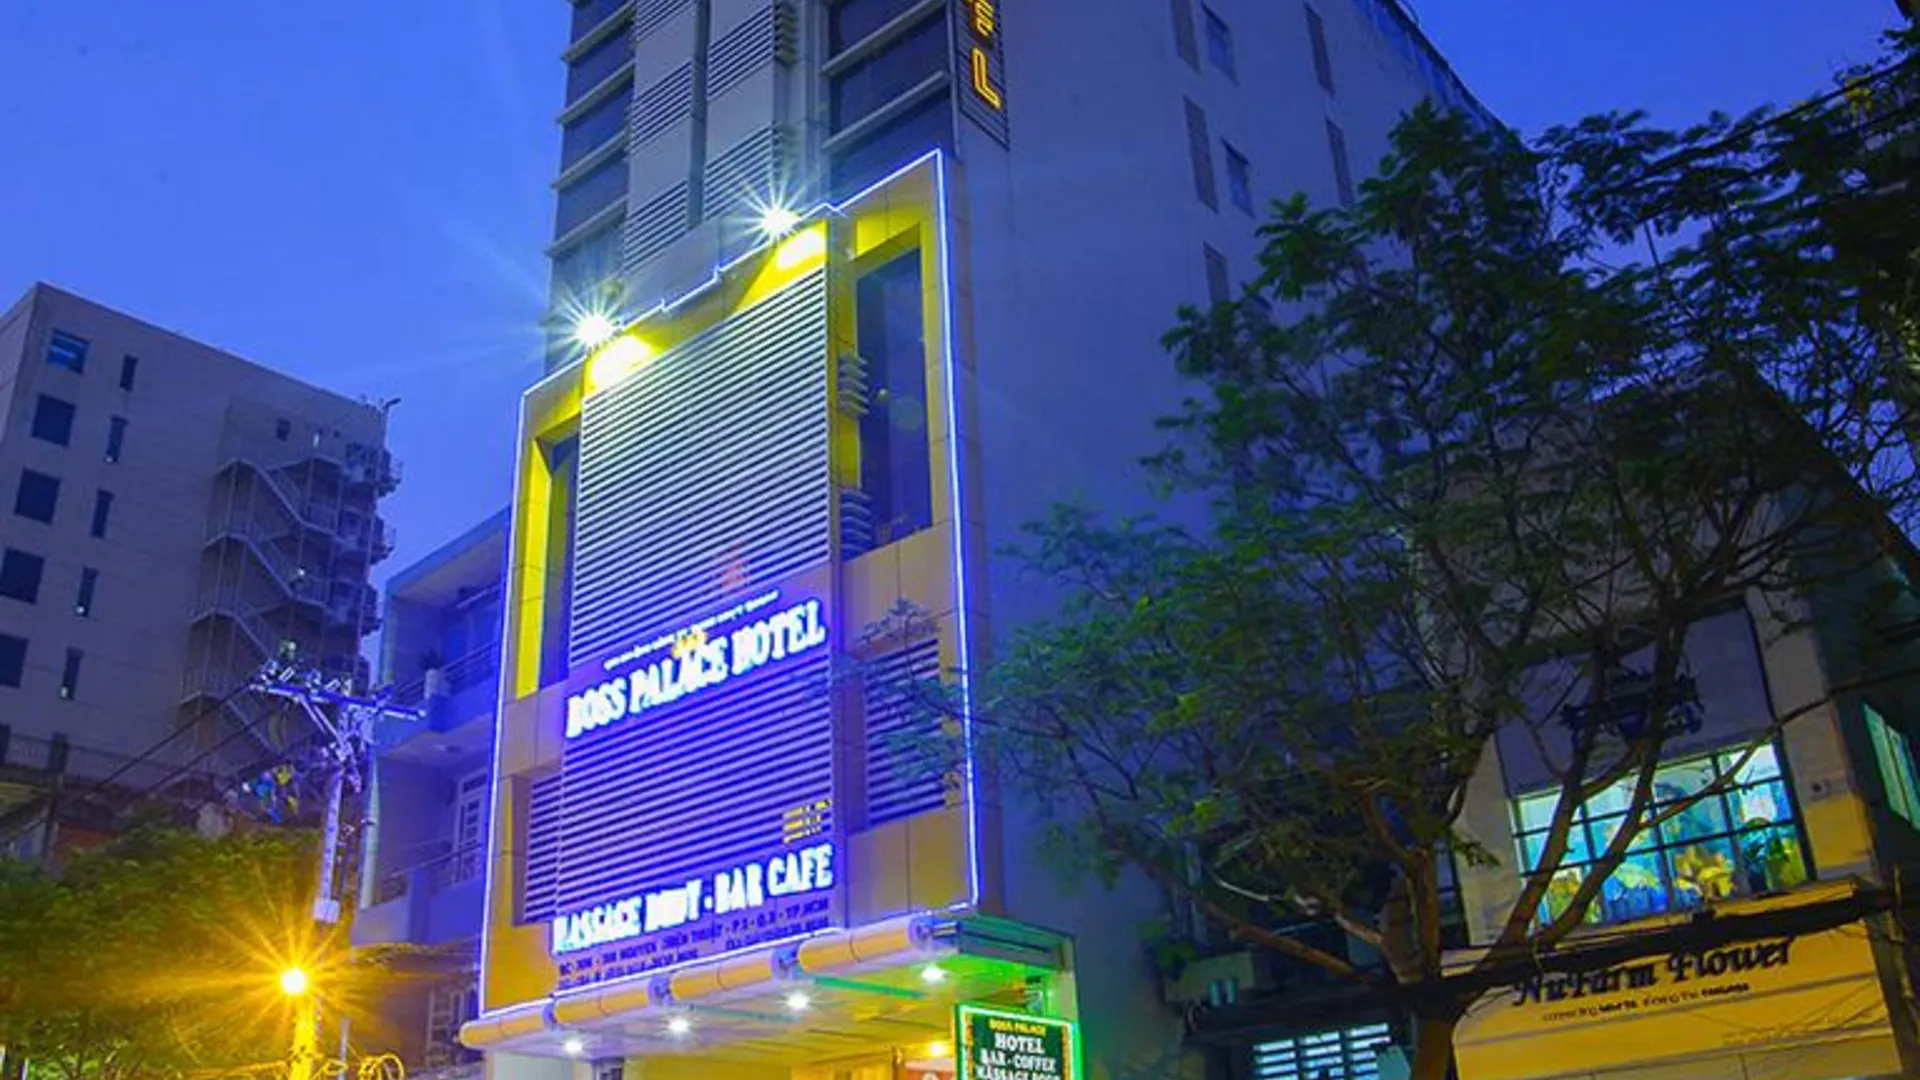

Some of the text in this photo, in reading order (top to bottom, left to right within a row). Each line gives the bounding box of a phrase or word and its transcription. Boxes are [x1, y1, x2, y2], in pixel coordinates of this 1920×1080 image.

[566, 677, 627, 738] BOSS
[731, 599, 826, 675] HOTEL
[715, 863, 763, 914] BAR
[1666, 936, 1796, 983] Flower
[994, 1032, 1046, 1054] HOTEL
[1013, 1052, 1056, 1073] COFFEE
